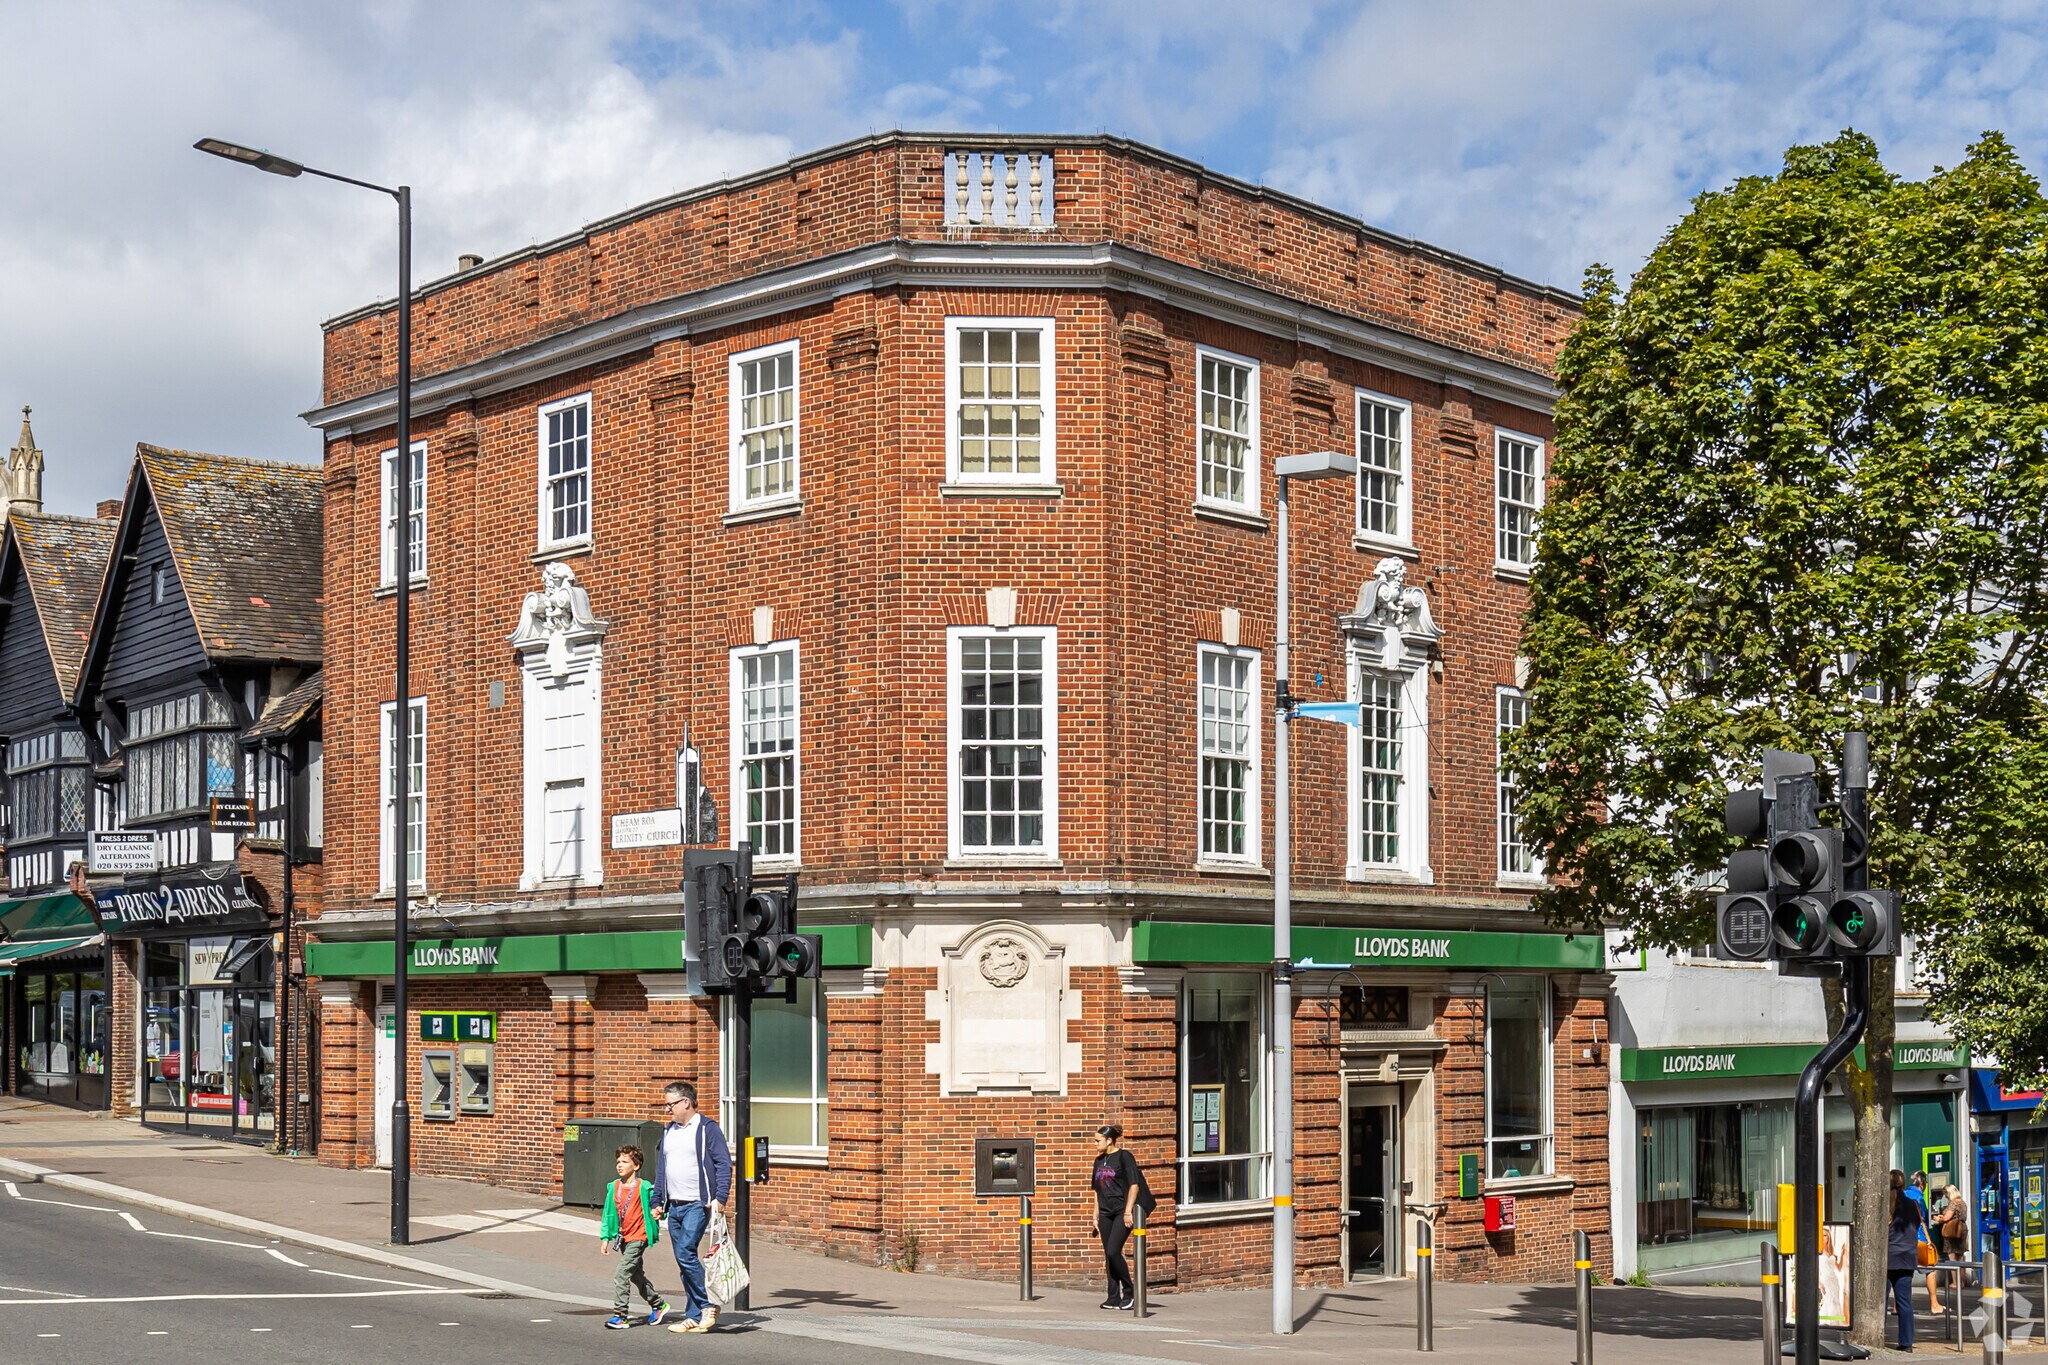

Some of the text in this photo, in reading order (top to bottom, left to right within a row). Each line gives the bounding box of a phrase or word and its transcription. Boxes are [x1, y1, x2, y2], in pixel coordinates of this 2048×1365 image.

[616, 818, 640, 828] CHEAM
[616, 830, 679, 844] TRINITY CHURCH
[115, 884, 230, 924] PRESS 2 DRESS
[1354, 937, 1450, 958] LLOYDS BANK
[194, 952, 207, 965] SEW
[414, 946, 499, 967] LLOYDS BANK
[1662, 1054, 1736, 1073] LLOYDS BANK
[1899, 1048, 1956, 1064] LLOYDS BANK
